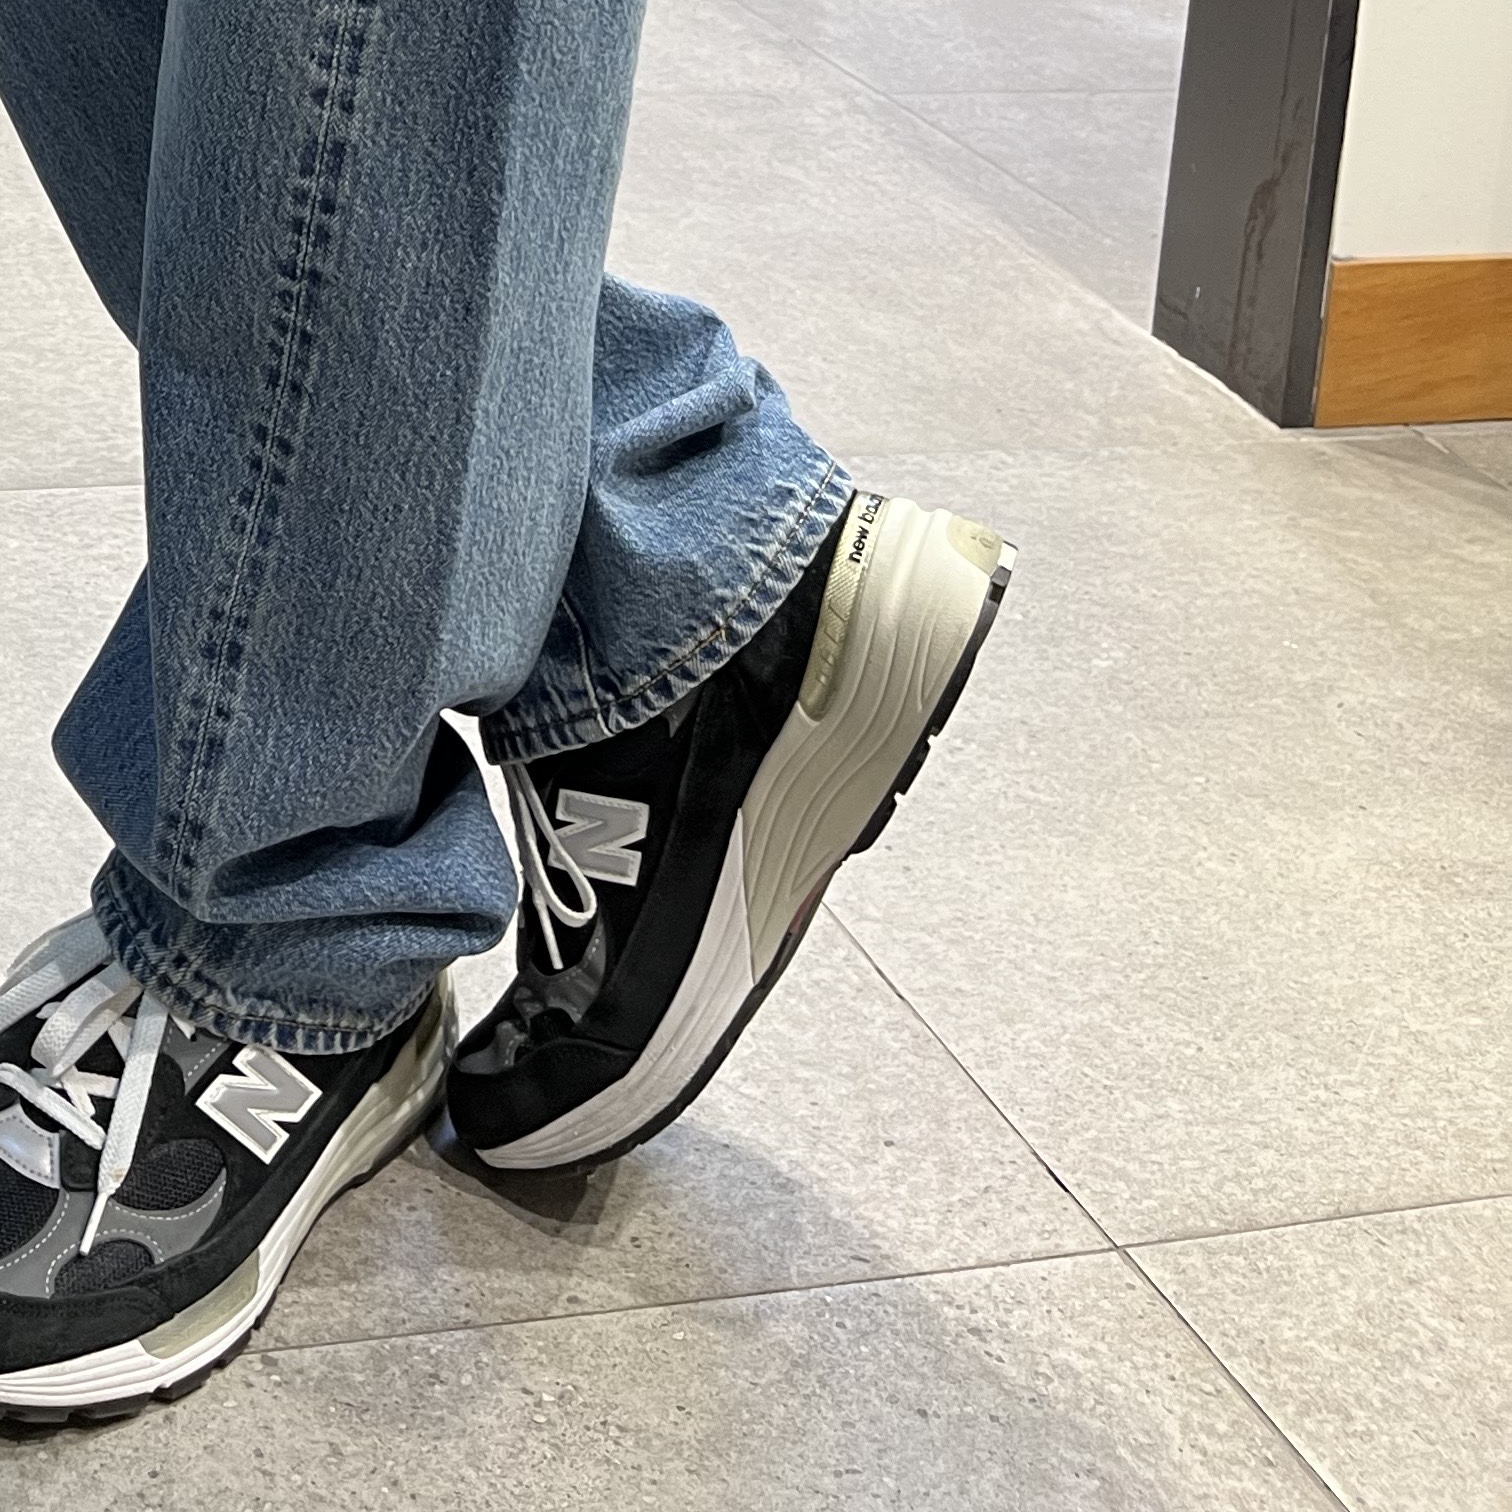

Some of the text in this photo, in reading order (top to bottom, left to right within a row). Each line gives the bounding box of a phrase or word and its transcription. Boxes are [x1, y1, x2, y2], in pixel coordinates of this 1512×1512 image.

[849, 526, 870, 564] new
[547, 788, 650, 886] N
[195, 1043, 323, 1165] N
